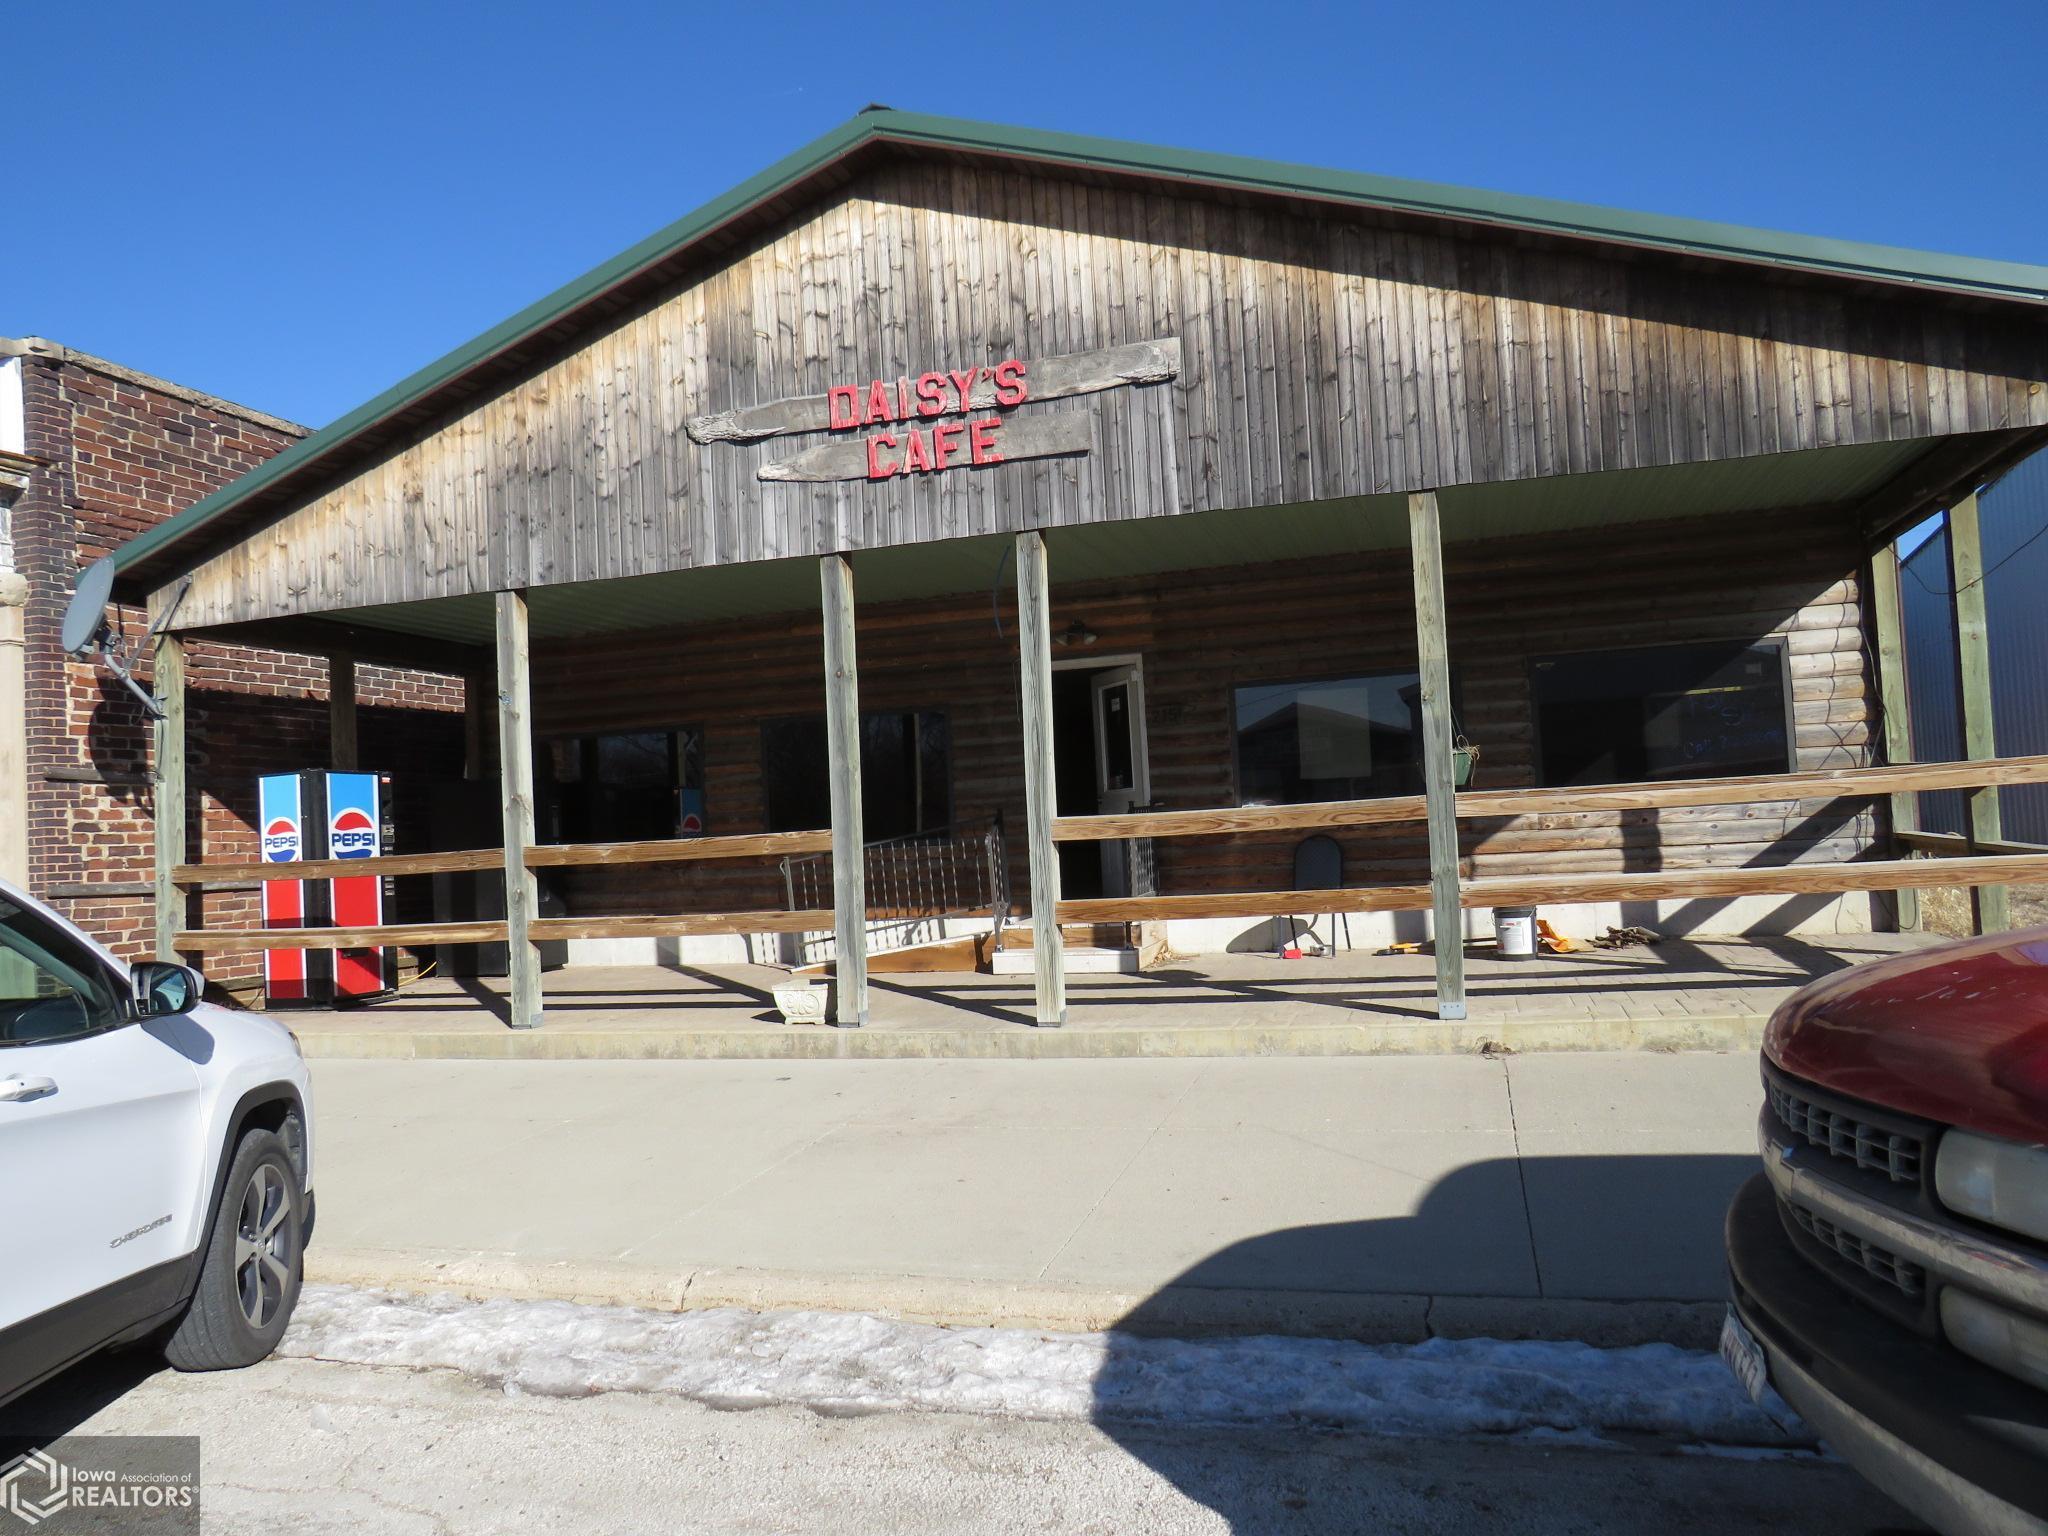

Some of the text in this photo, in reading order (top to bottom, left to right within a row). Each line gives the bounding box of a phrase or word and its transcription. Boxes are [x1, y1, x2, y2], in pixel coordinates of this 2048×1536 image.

[828, 358, 1027, 430] DAISY'S
[866, 416, 1004, 479] CAFE
[265, 836, 298, 848] PEPSI
[332, 833, 375, 847] PEPSI
